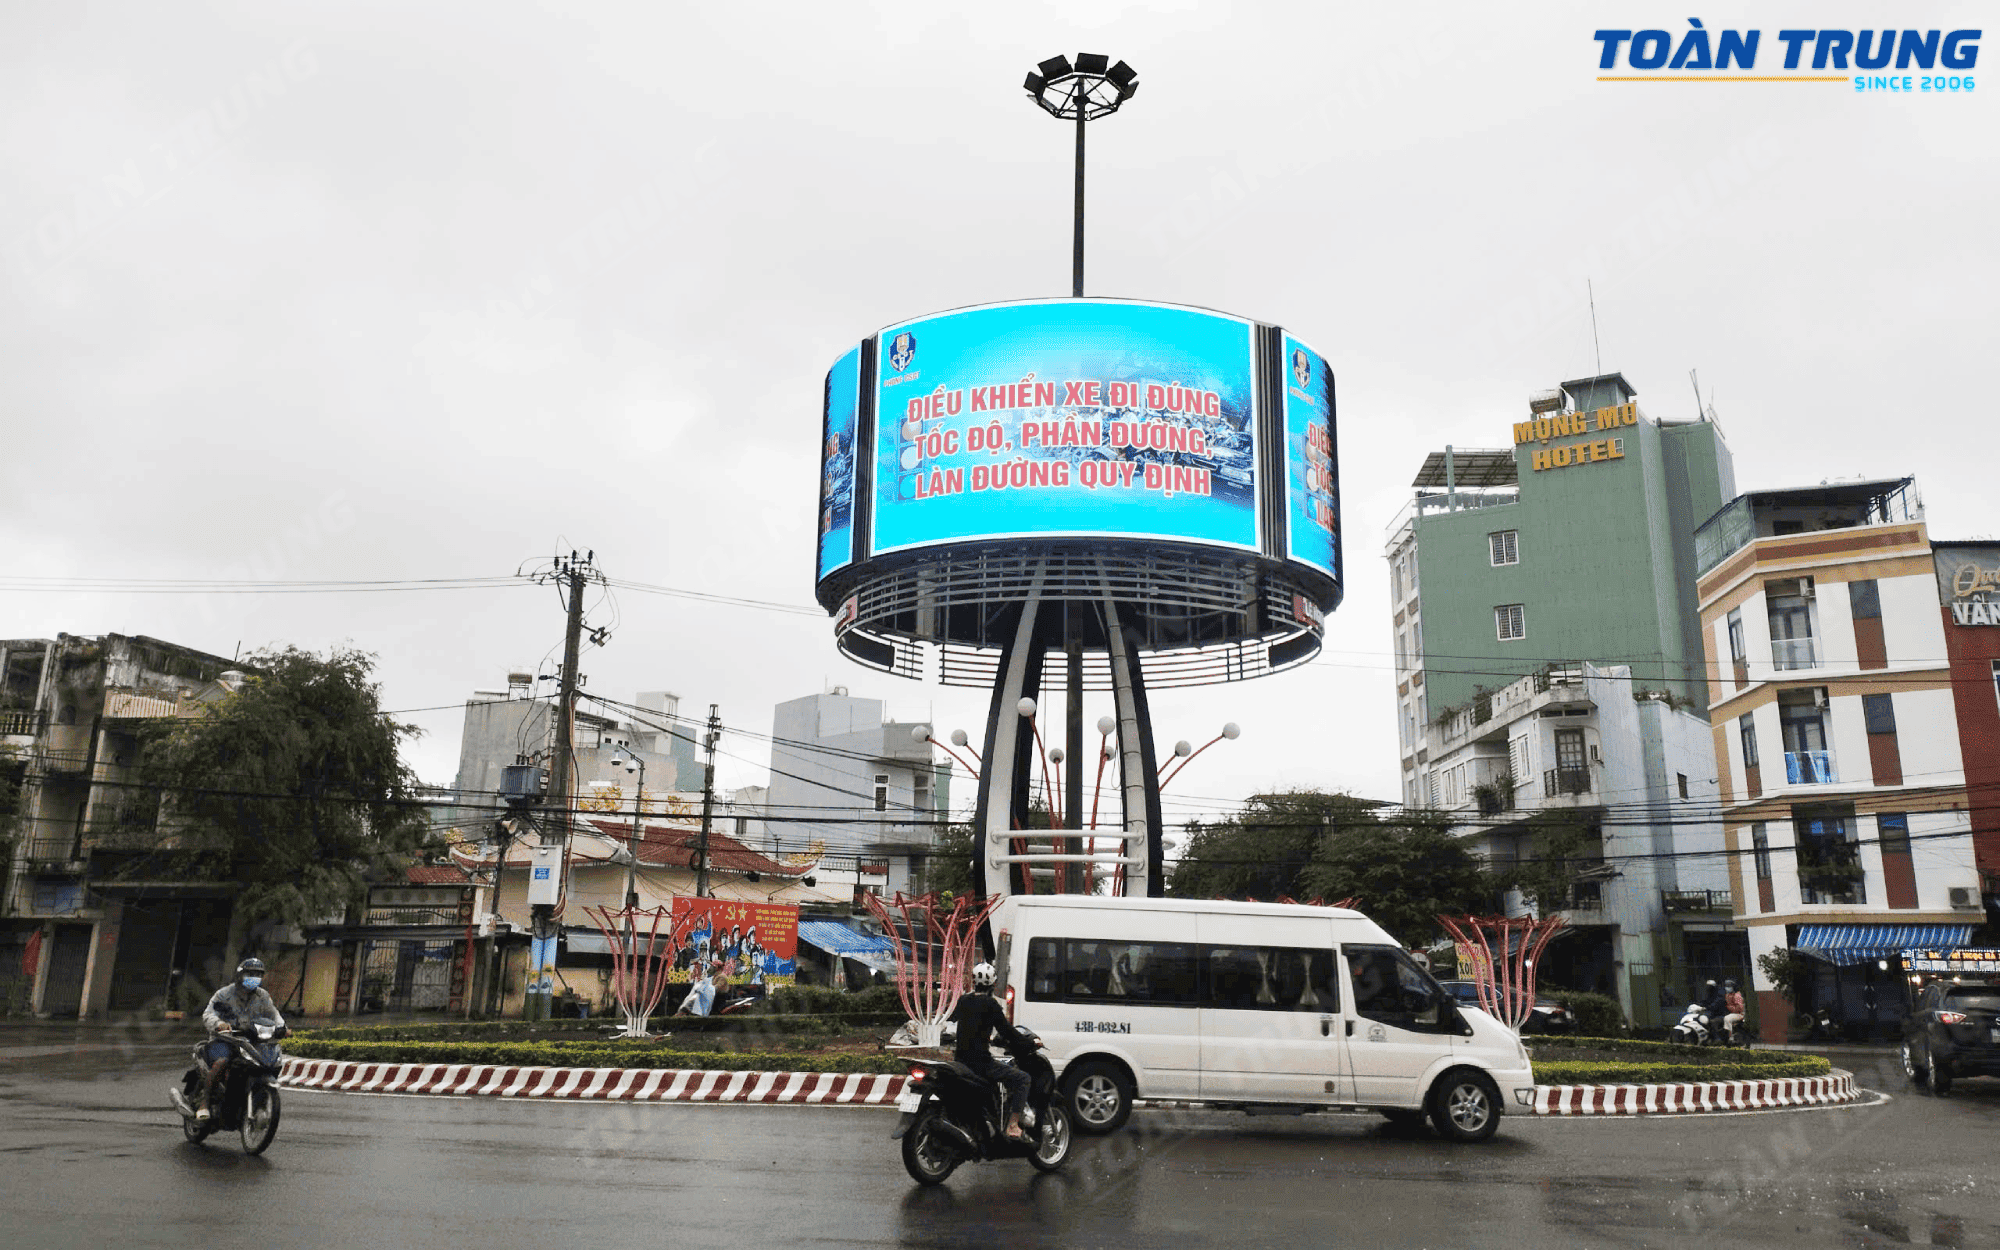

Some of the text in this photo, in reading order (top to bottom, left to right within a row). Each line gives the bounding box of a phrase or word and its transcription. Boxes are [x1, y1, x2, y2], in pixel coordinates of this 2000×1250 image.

[908, 372, 1220, 424] ĐIỀU KHIỂN XE ĐI ĐÚNG
[914, 411, 1213, 460] TỐC ĐỘ, PHẦN ĐƯỜNG,
[1531, 437, 1626, 472] HOTEL
[916, 456, 1211, 499] LÀN ĐƯỜNG QUY ĐỊNH
